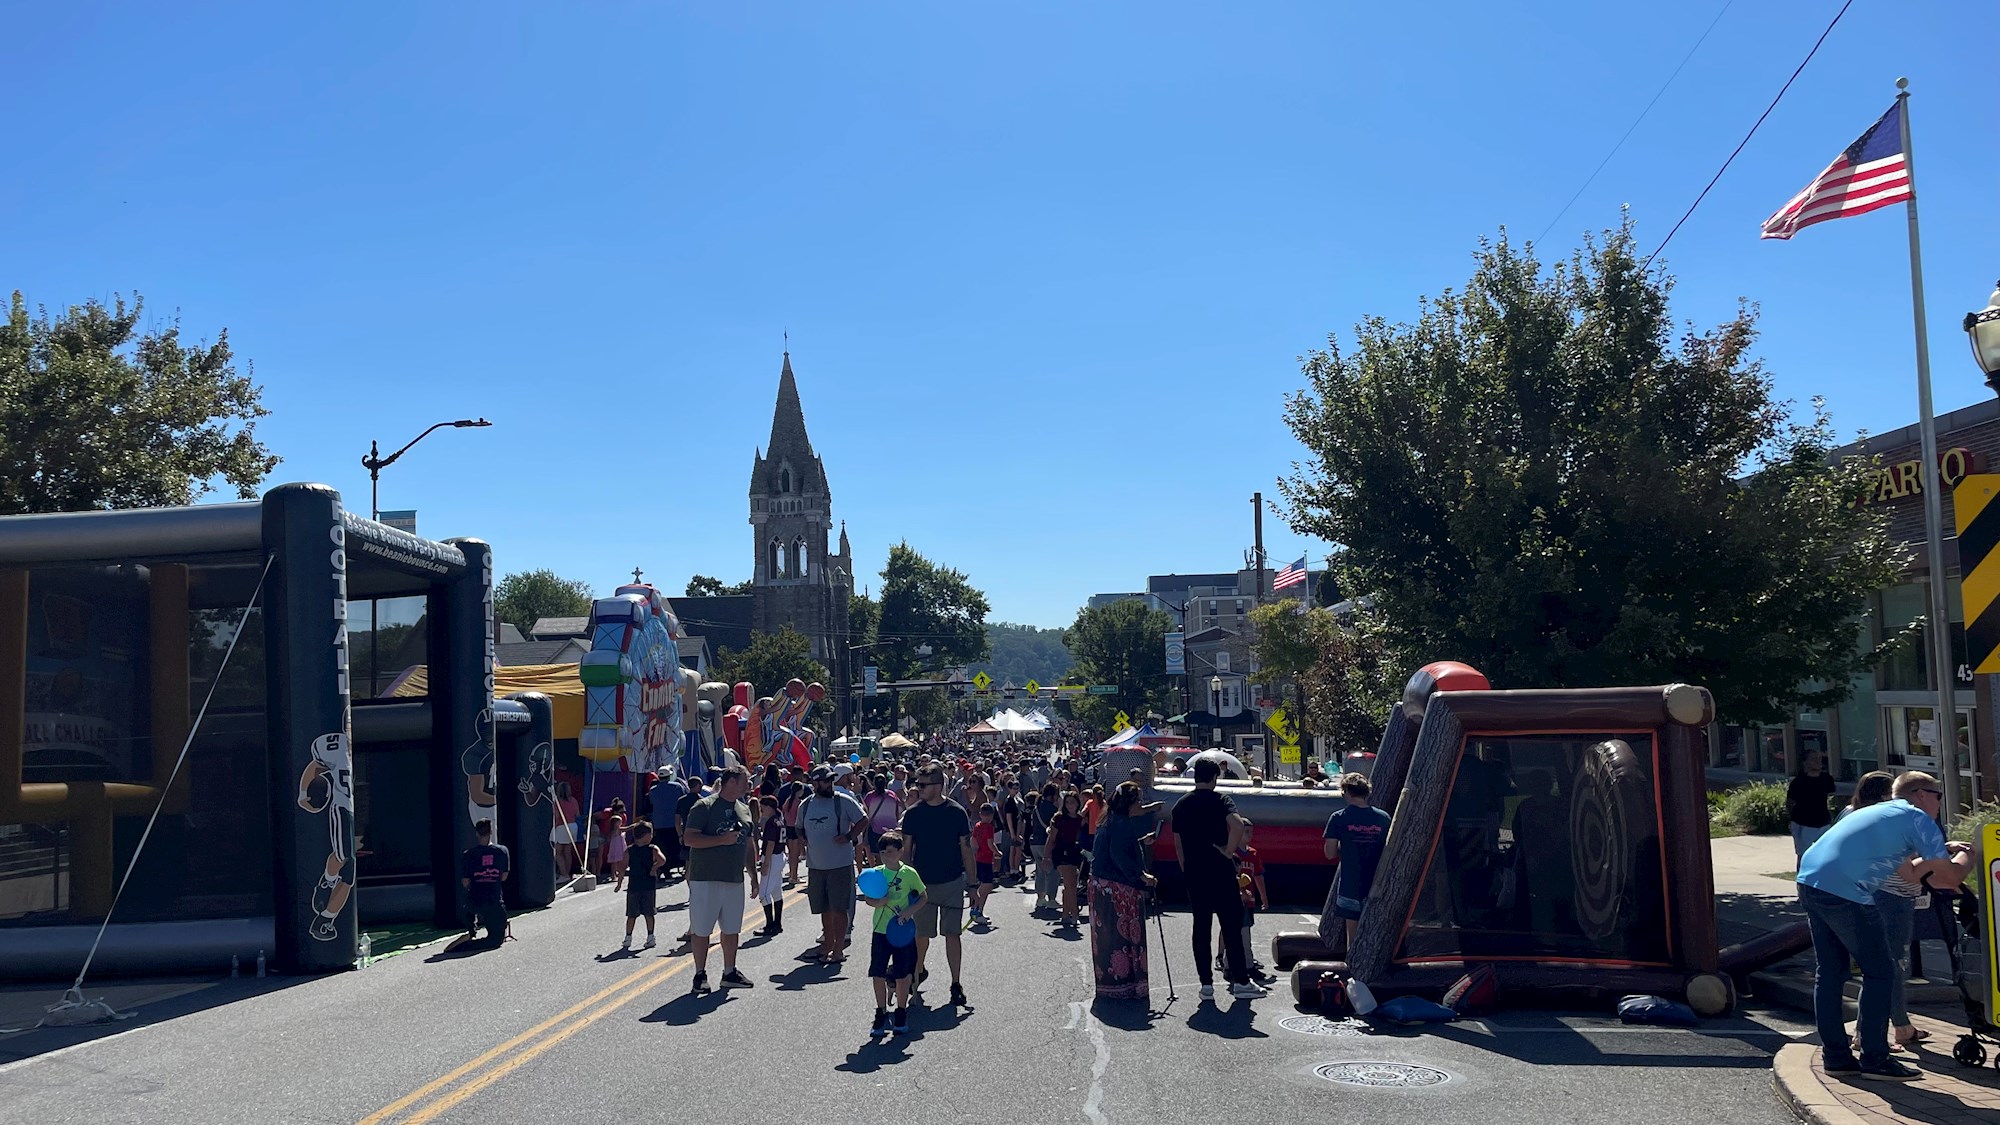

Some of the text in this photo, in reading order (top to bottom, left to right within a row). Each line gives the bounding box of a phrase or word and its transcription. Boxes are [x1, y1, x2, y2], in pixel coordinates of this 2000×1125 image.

[344, 516, 467, 567] Beanie Bounce Party Rentals
[362, 540, 449, 575] www.beaniebounce.com
[329, 500, 350, 695] FOOTBALL
[482, 552, 495, 709] CHALLENGE
